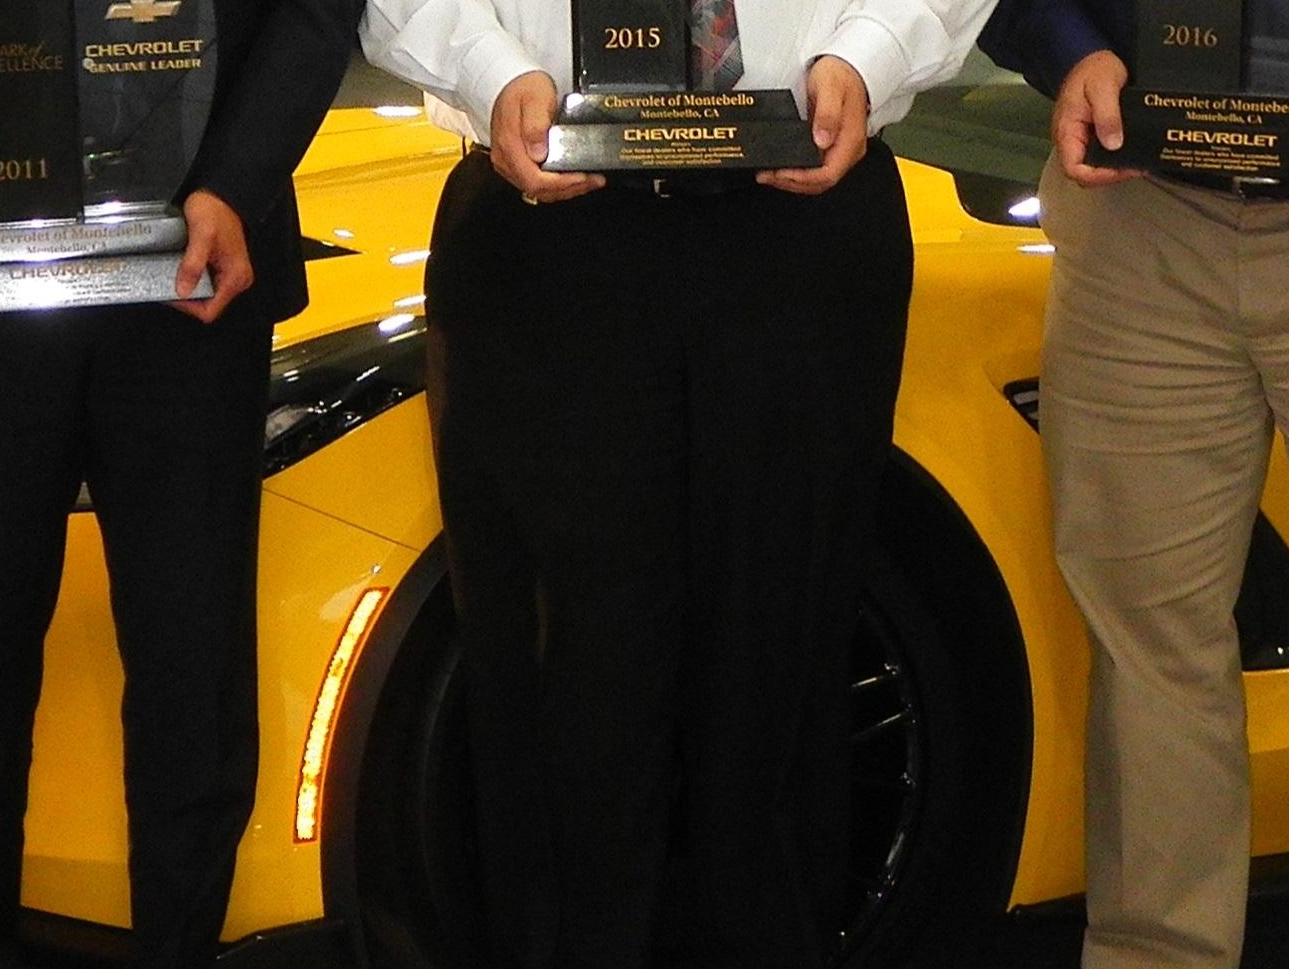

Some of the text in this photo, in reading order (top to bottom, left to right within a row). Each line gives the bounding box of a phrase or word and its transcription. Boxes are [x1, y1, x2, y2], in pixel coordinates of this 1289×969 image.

[604, 27, 661, 49] 2015
[1162, 23, 1218, 47] 2016
[85, 39, 204, 57] CHEVROLET
[90, 58, 202, 73] GENUINE LEADER
[604, 93, 755, 108] Chevrolet of Montebello
[1144, 93, 1210, 109] Chevrolet
[1212, 98, 1229, 110] of
[639, 108, 720, 120] Montebello, CA
[1246, 114, 1263, 124] CA
[623, 127, 738, 141] CHEVROLET
[1166, 129, 1279, 148] CHEVROLET
[53, 228, 67, 242] of
[70, 224, 152, 240] Montebello
[10, 260, 127, 280] CHEVROLET
